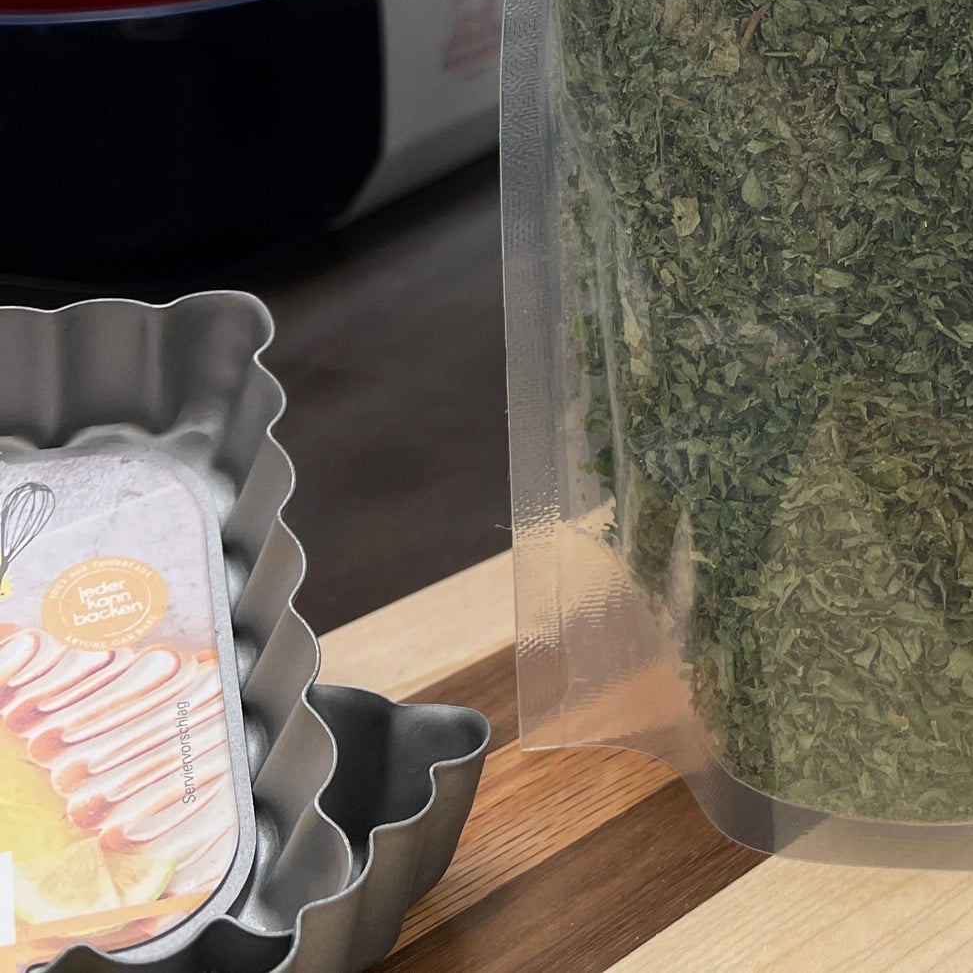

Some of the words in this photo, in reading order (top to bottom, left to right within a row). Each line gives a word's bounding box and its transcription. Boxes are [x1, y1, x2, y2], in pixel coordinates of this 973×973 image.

[78, 579, 126, 604] jeder
[85, 590, 132, 610] kann
[72, 601, 143, 627] backen
[175, 701, 197, 805] Serviervorschlag
